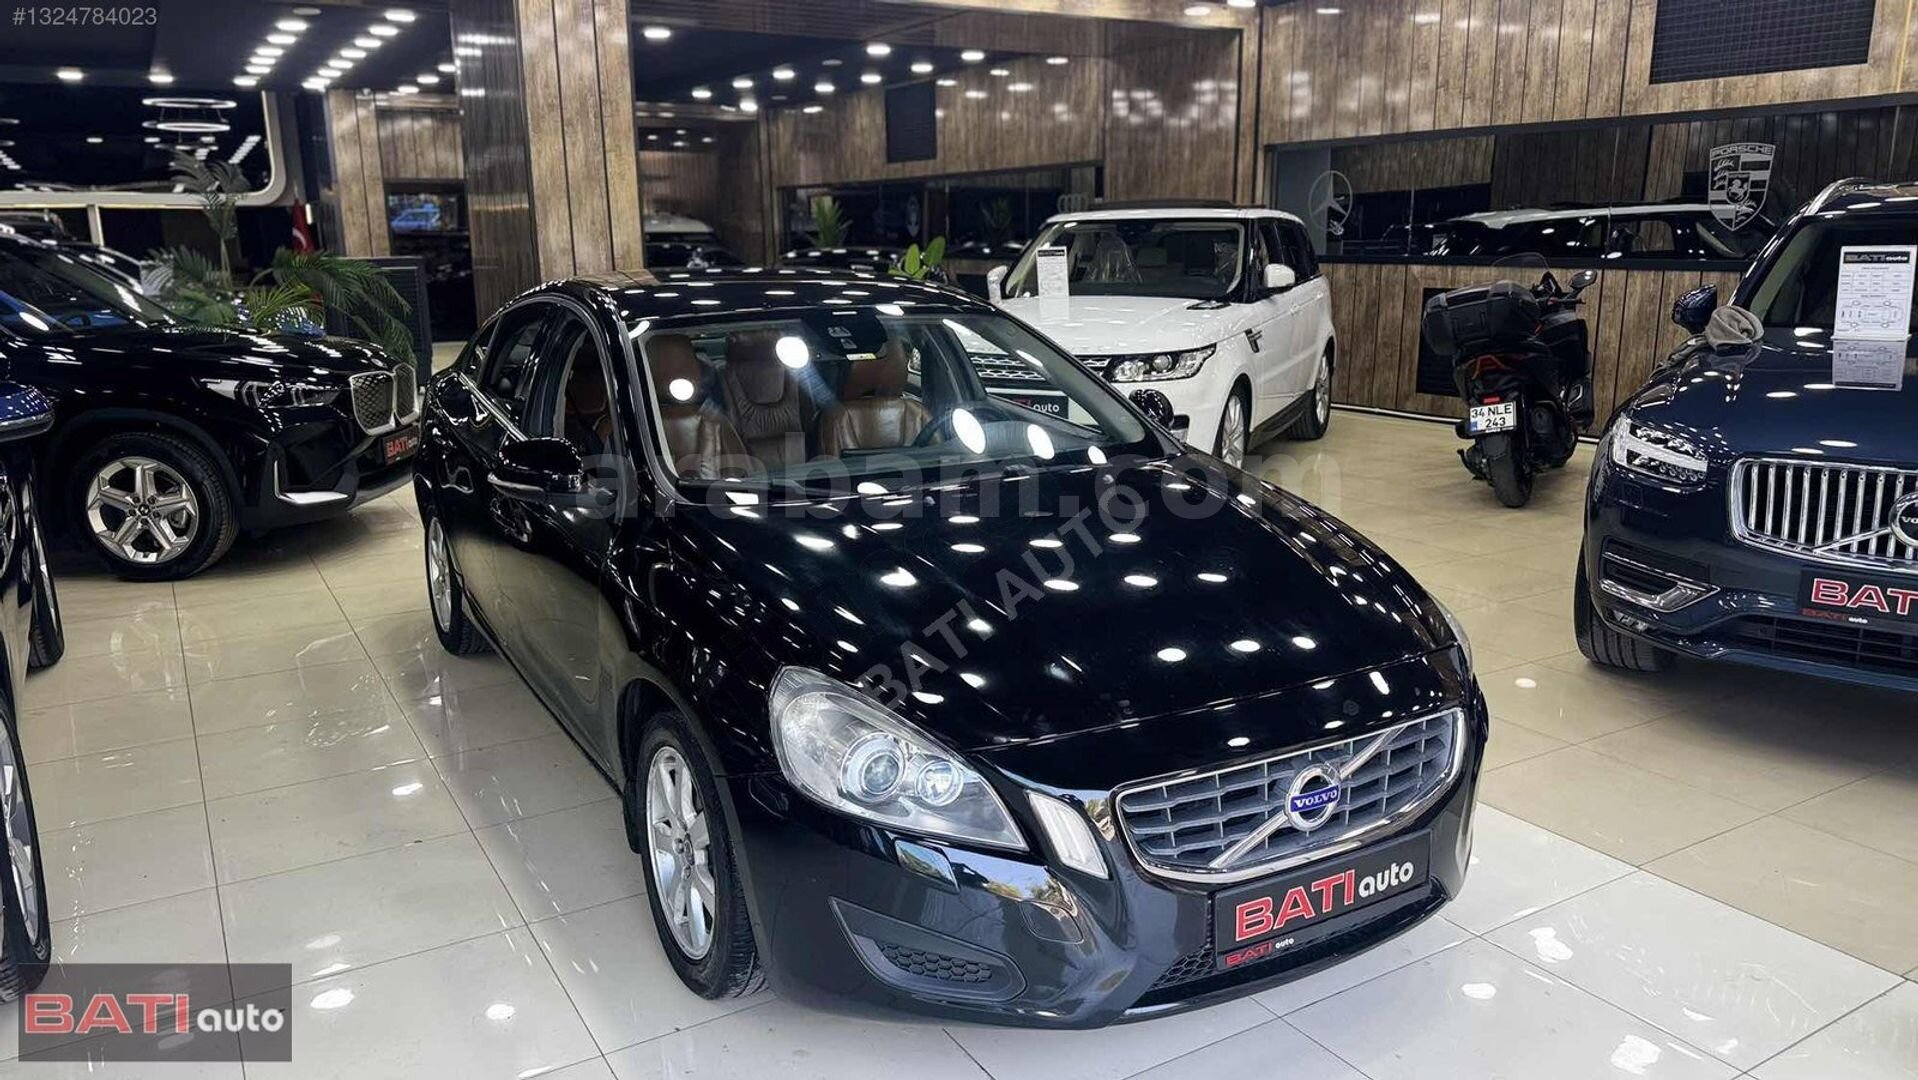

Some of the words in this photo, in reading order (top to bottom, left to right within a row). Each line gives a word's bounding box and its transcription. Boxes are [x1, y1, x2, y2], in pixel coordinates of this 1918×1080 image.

[1710, 145, 1773, 157] PORSCHE
[1033, 403, 1060, 413] auto
[1471, 408, 1485, 418] 34
[1487, 404, 1512, 416] NLE
[1485, 416, 1506, 427] 243
[1811, 578, 1918, 615] BAT
[1293, 789, 1338, 808] VOLVO
[1235, 869, 1356, 942] BATI
[1358, 861, 1415, 898] auto
[1226, 942, 1273, 966] BATI
[1275, 937, 1295, 949] auto
